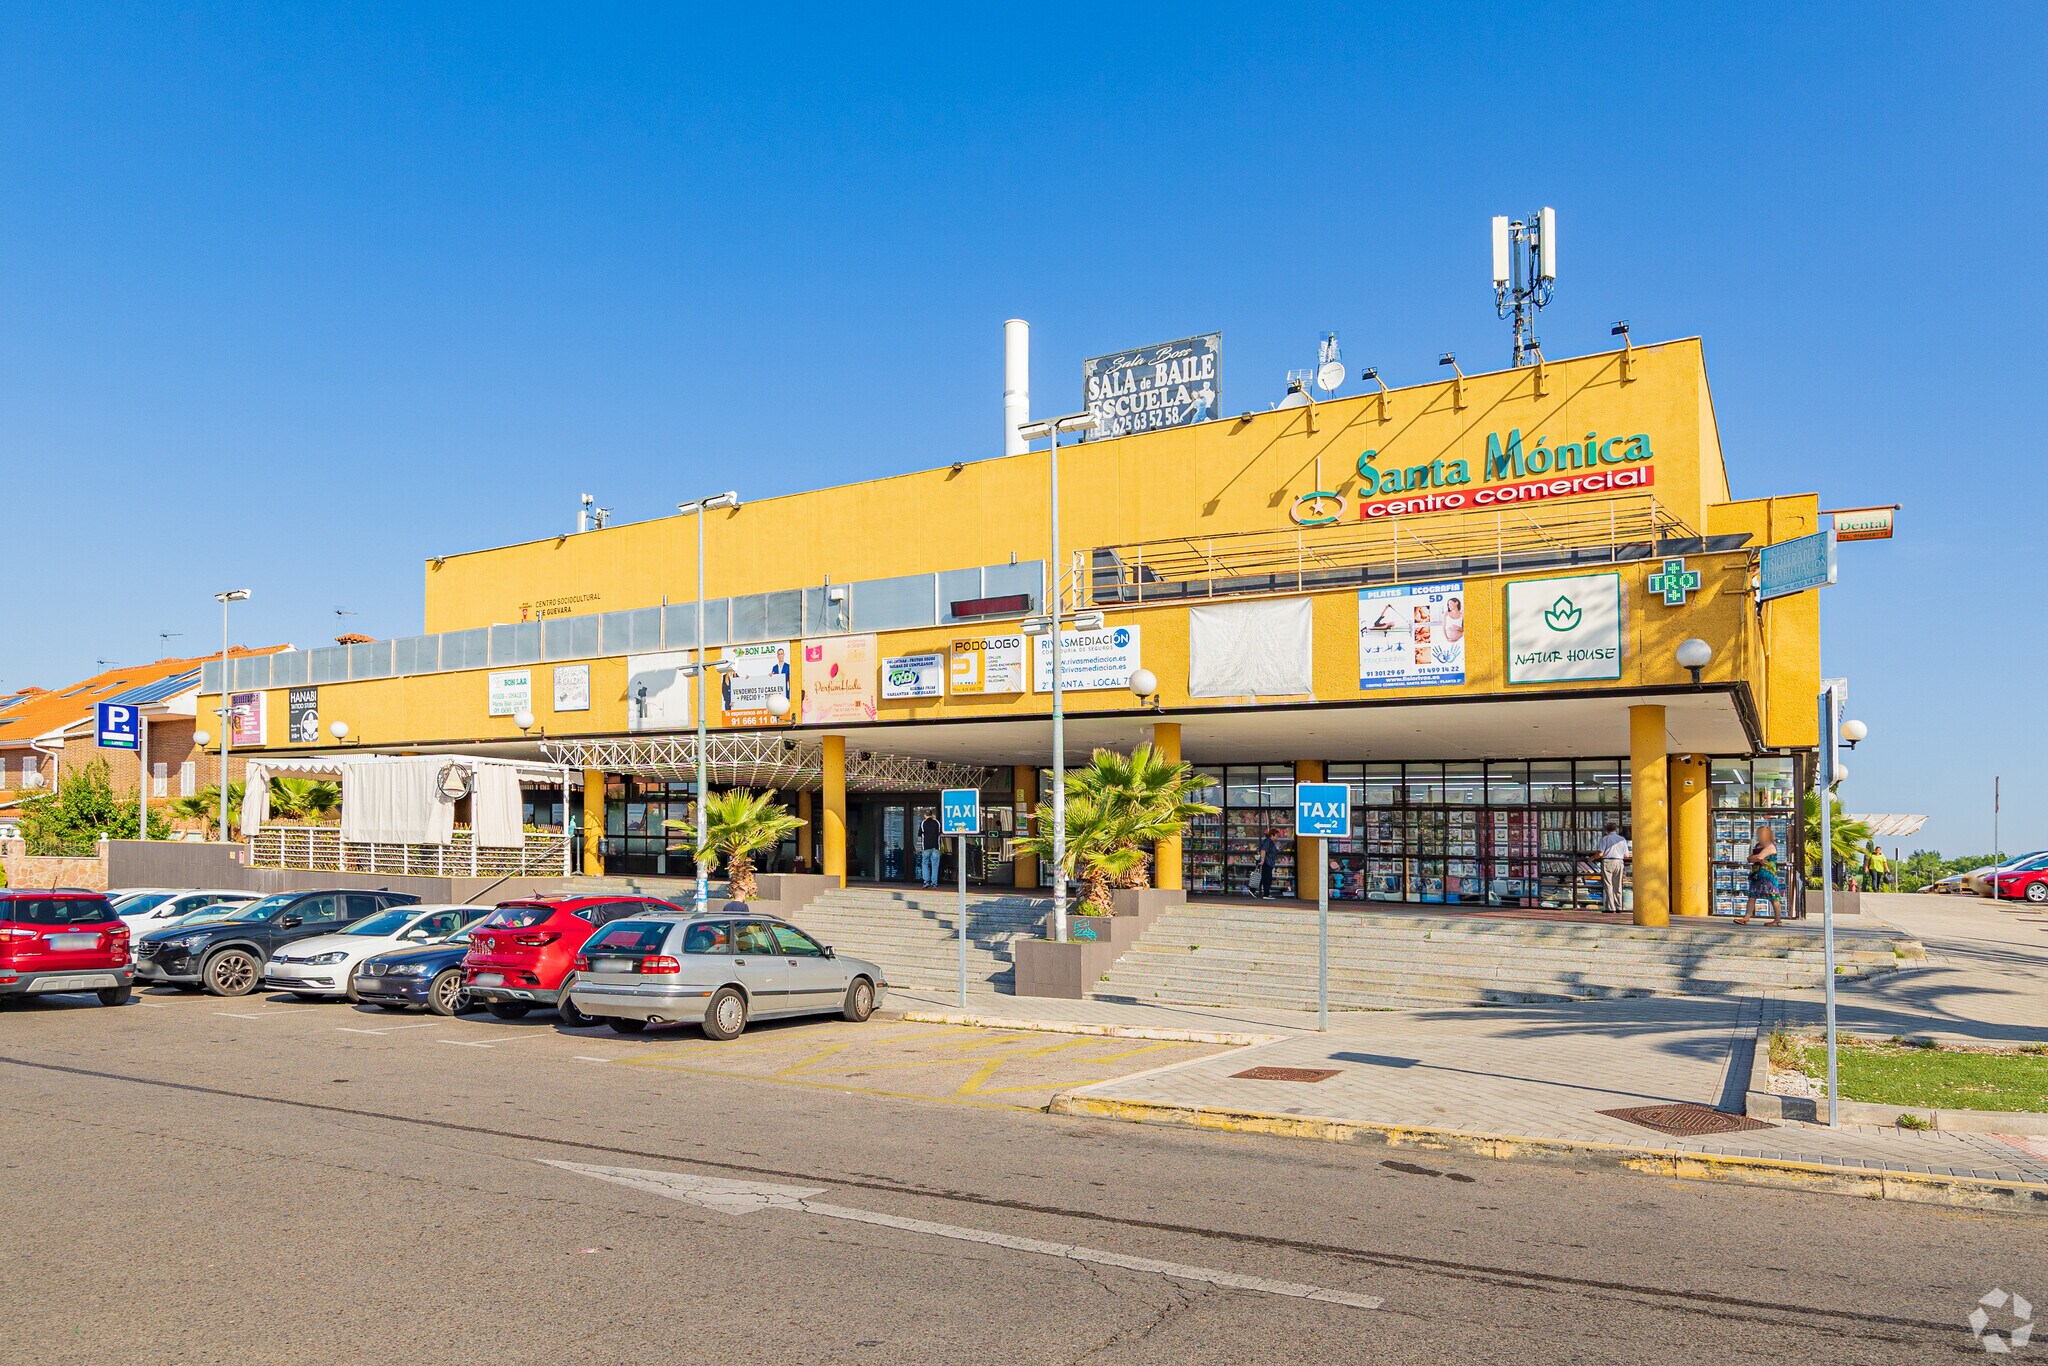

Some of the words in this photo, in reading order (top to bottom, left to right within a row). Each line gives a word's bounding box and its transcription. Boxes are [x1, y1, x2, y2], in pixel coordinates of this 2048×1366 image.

[1147, 346, 1192, 366] Boss
[1088, 368, 1137, 401] SALA
[1140, 377, 1151, 390] de
[1154, 353, 1214, 388] BAILE
[1088, 384, 1192, 420] ESCUELA
[1113, 415, 1132, 435] 625
[1134, 411, 1147, 431] 63
[1149, 409, 1163, 427] 52
[1165, 406, 1179, 425] 58
[1357, 448, 1472, 497] Santa
[1485, 428, 1654, 481] Mónica
[1366, 493, 1466, 518] centro
[1474, 467, 1647, 504] comercial
[1840, 519, 1887, 531] Dental
[1650, 573, 1694, 591] TRO
[535, 598, 556, 608] CENTRO
[557, 593, 601, 605] SOCIOCULTURAL
[1367, 589, 1402, 599] PILATES
[1428, 594, 1443, 603] 5D
[535, 609, 546, 617] CE
[546, 606, 572, 616] GUEVARA
[744, 647, 759, 656] BON
[761, 645, 776, 654] LAR
[1514, 650, 1563, 666] NATUR
[1566, 648, 1616, 662] HOUSE
[1045, 655, 1127, 666] ww.rivasmediacion.es
[1045, 664, 1127, 675] inf@rivasmediacion.es
[516, 677, 527, 685] LAR
[1051, 680, 1084, 689] ANTA
[1093, 678, 1121, 687] LOCAL
[290, 690, 317, 703] HANABI
[733, 687, 758, 695] VENDEMOS
[108, 706, 130, 731] P
[731, 717, 740, 725] 91
[742, 716, 757, 725] 666
[758, 716, 768, 724] 11
[945, 805, 976, 818] TAXI
[1300, 802, 1345, 818] TAXI
[1331, 820, 1338, 828] 2
